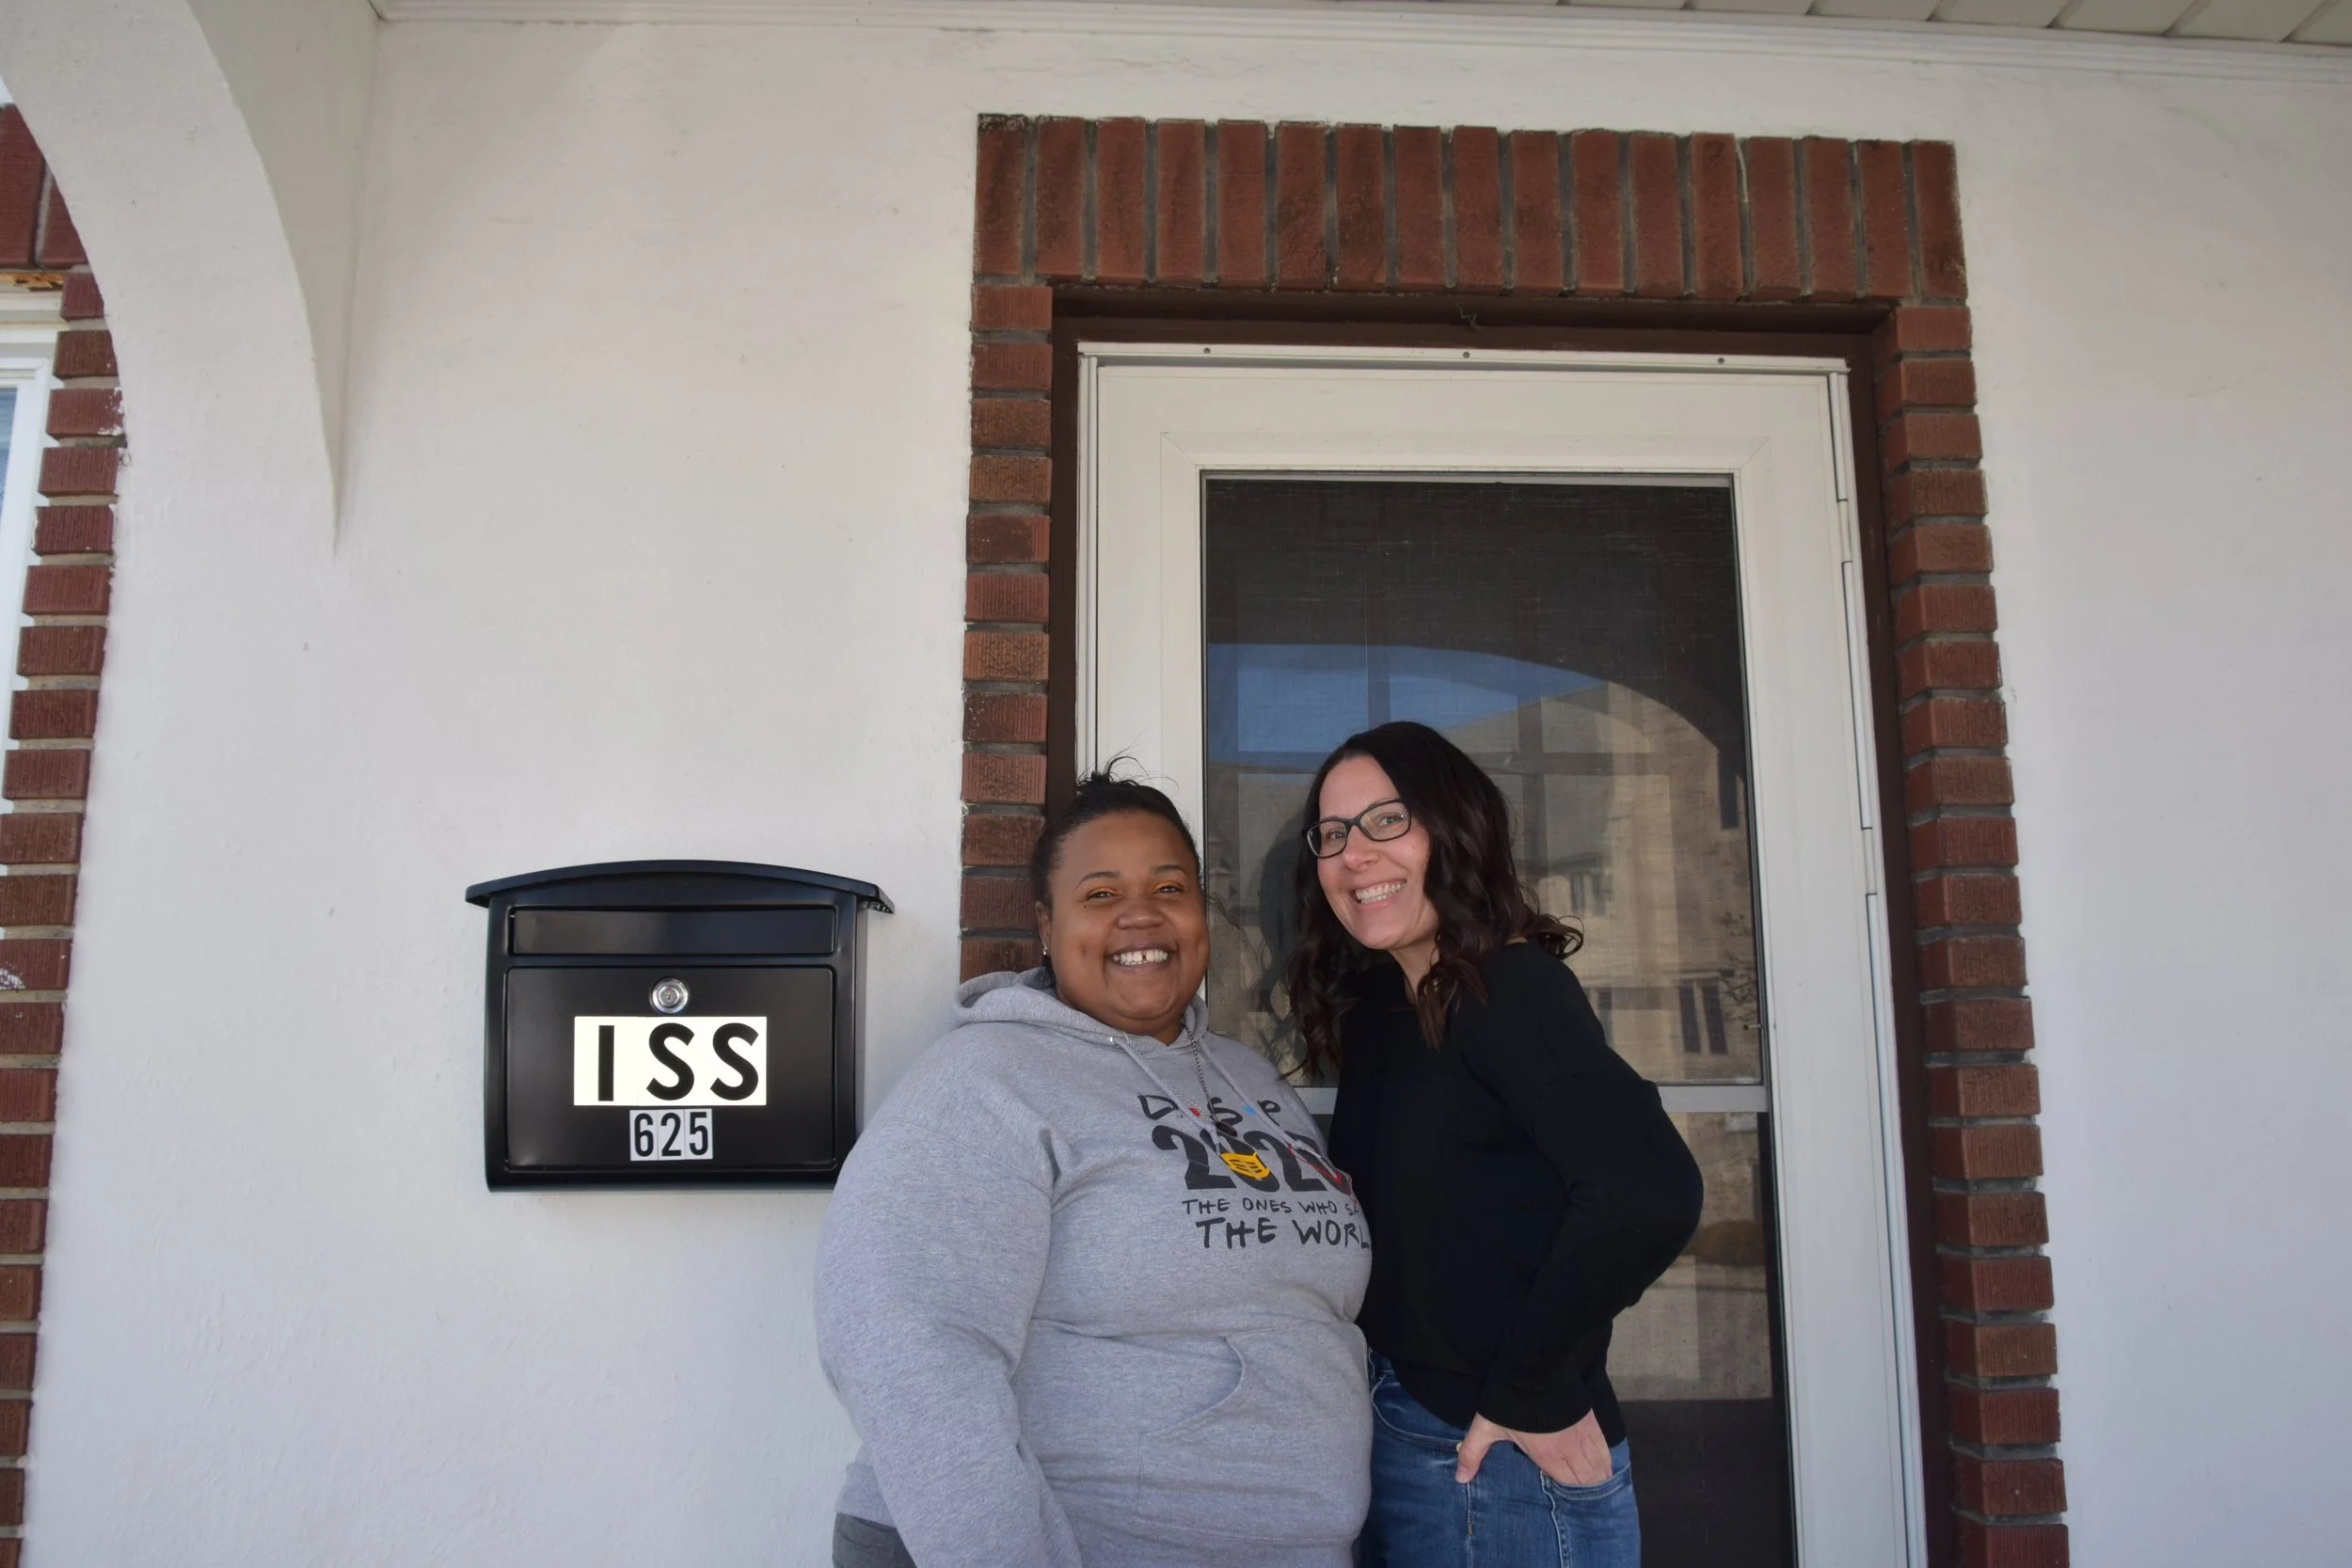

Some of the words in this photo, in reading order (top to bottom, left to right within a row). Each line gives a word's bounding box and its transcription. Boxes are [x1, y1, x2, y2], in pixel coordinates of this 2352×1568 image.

[597, 1022, 759, 1101] ISS
[633, 1111, 709, 1157] 625
[1182, 1198, 1231, 1215] THE
[1243, 1197, 1292, 1214] ONES
[1298, 1200, 1338, 1215] WHO
[1196, 1217, 1278, 1250] THE
